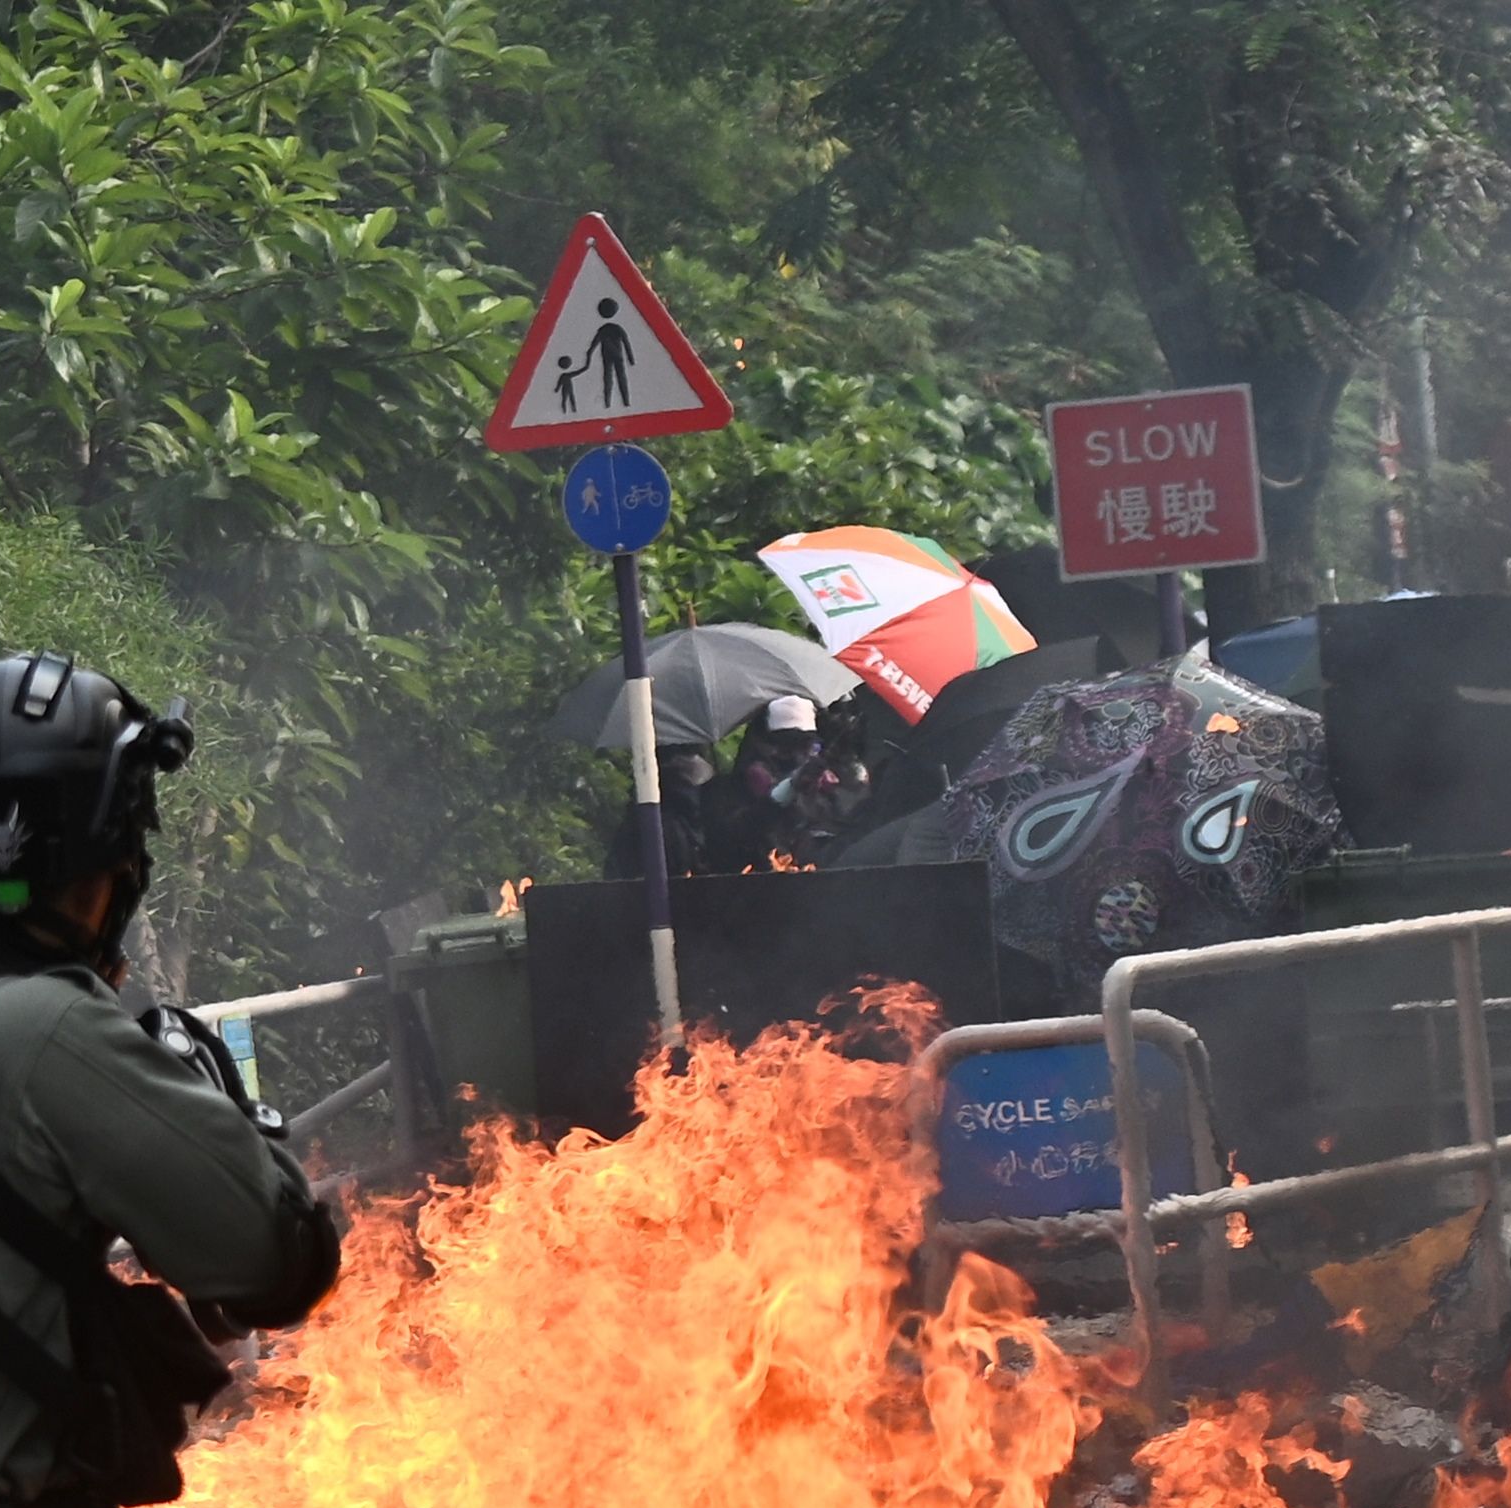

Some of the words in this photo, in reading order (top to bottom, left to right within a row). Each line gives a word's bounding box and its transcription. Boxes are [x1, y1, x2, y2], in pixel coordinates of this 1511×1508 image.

[1085, 420, 1218, 467] SLOW
[1097, 478, 1220, 545] 慢駛
[864, 645, 934, 715] 7-ELEVE
[955, 1097, 1054, 1134] CYCLE
